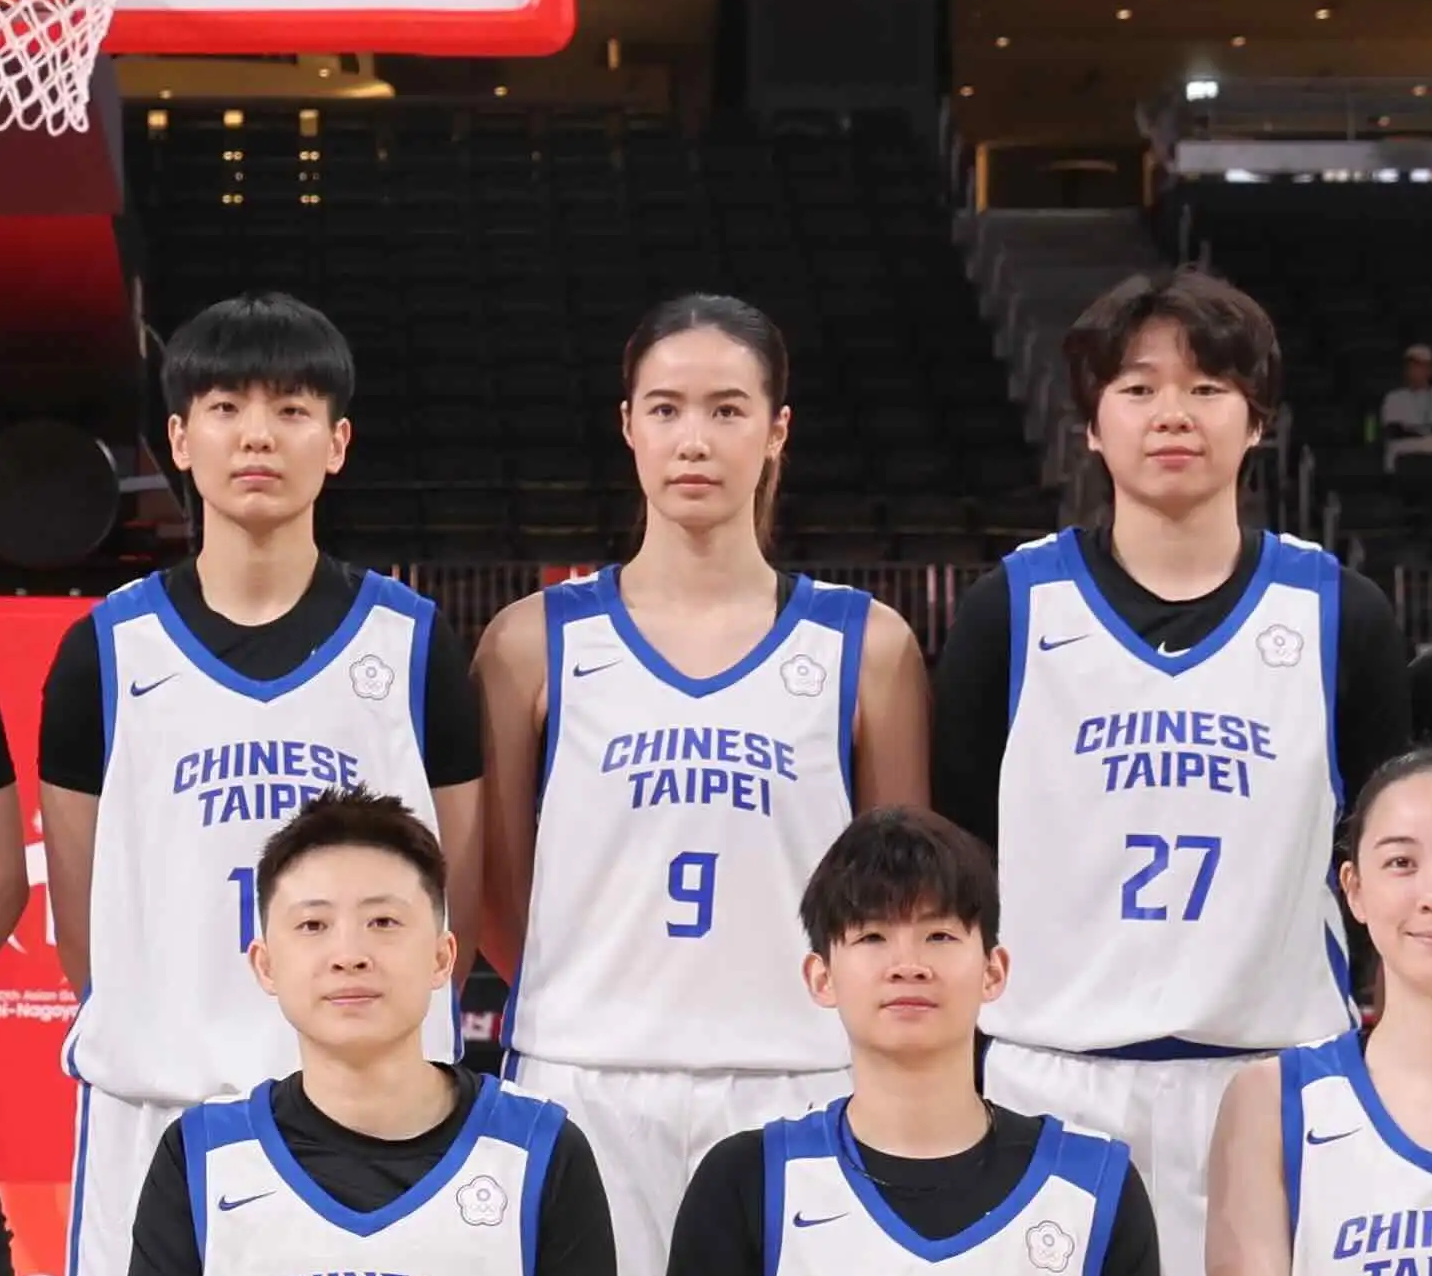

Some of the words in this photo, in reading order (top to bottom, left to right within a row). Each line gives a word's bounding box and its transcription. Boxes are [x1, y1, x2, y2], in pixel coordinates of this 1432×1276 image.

[600, 727, 799, 782] CHINESE
[1074, 710, 1277, 760] CHINESE
[173, 740, 359, 794] CHINESE
[628, 769, 771, 817] TAIPEI
[1101, 752, 1250, 798] TAIPEI
[197, 783, 321, 828] TAIP
[666, 851, 720, 939] 9
[1120, 834, 1222, 921] 27
[227, 867, 255, 954] 1
